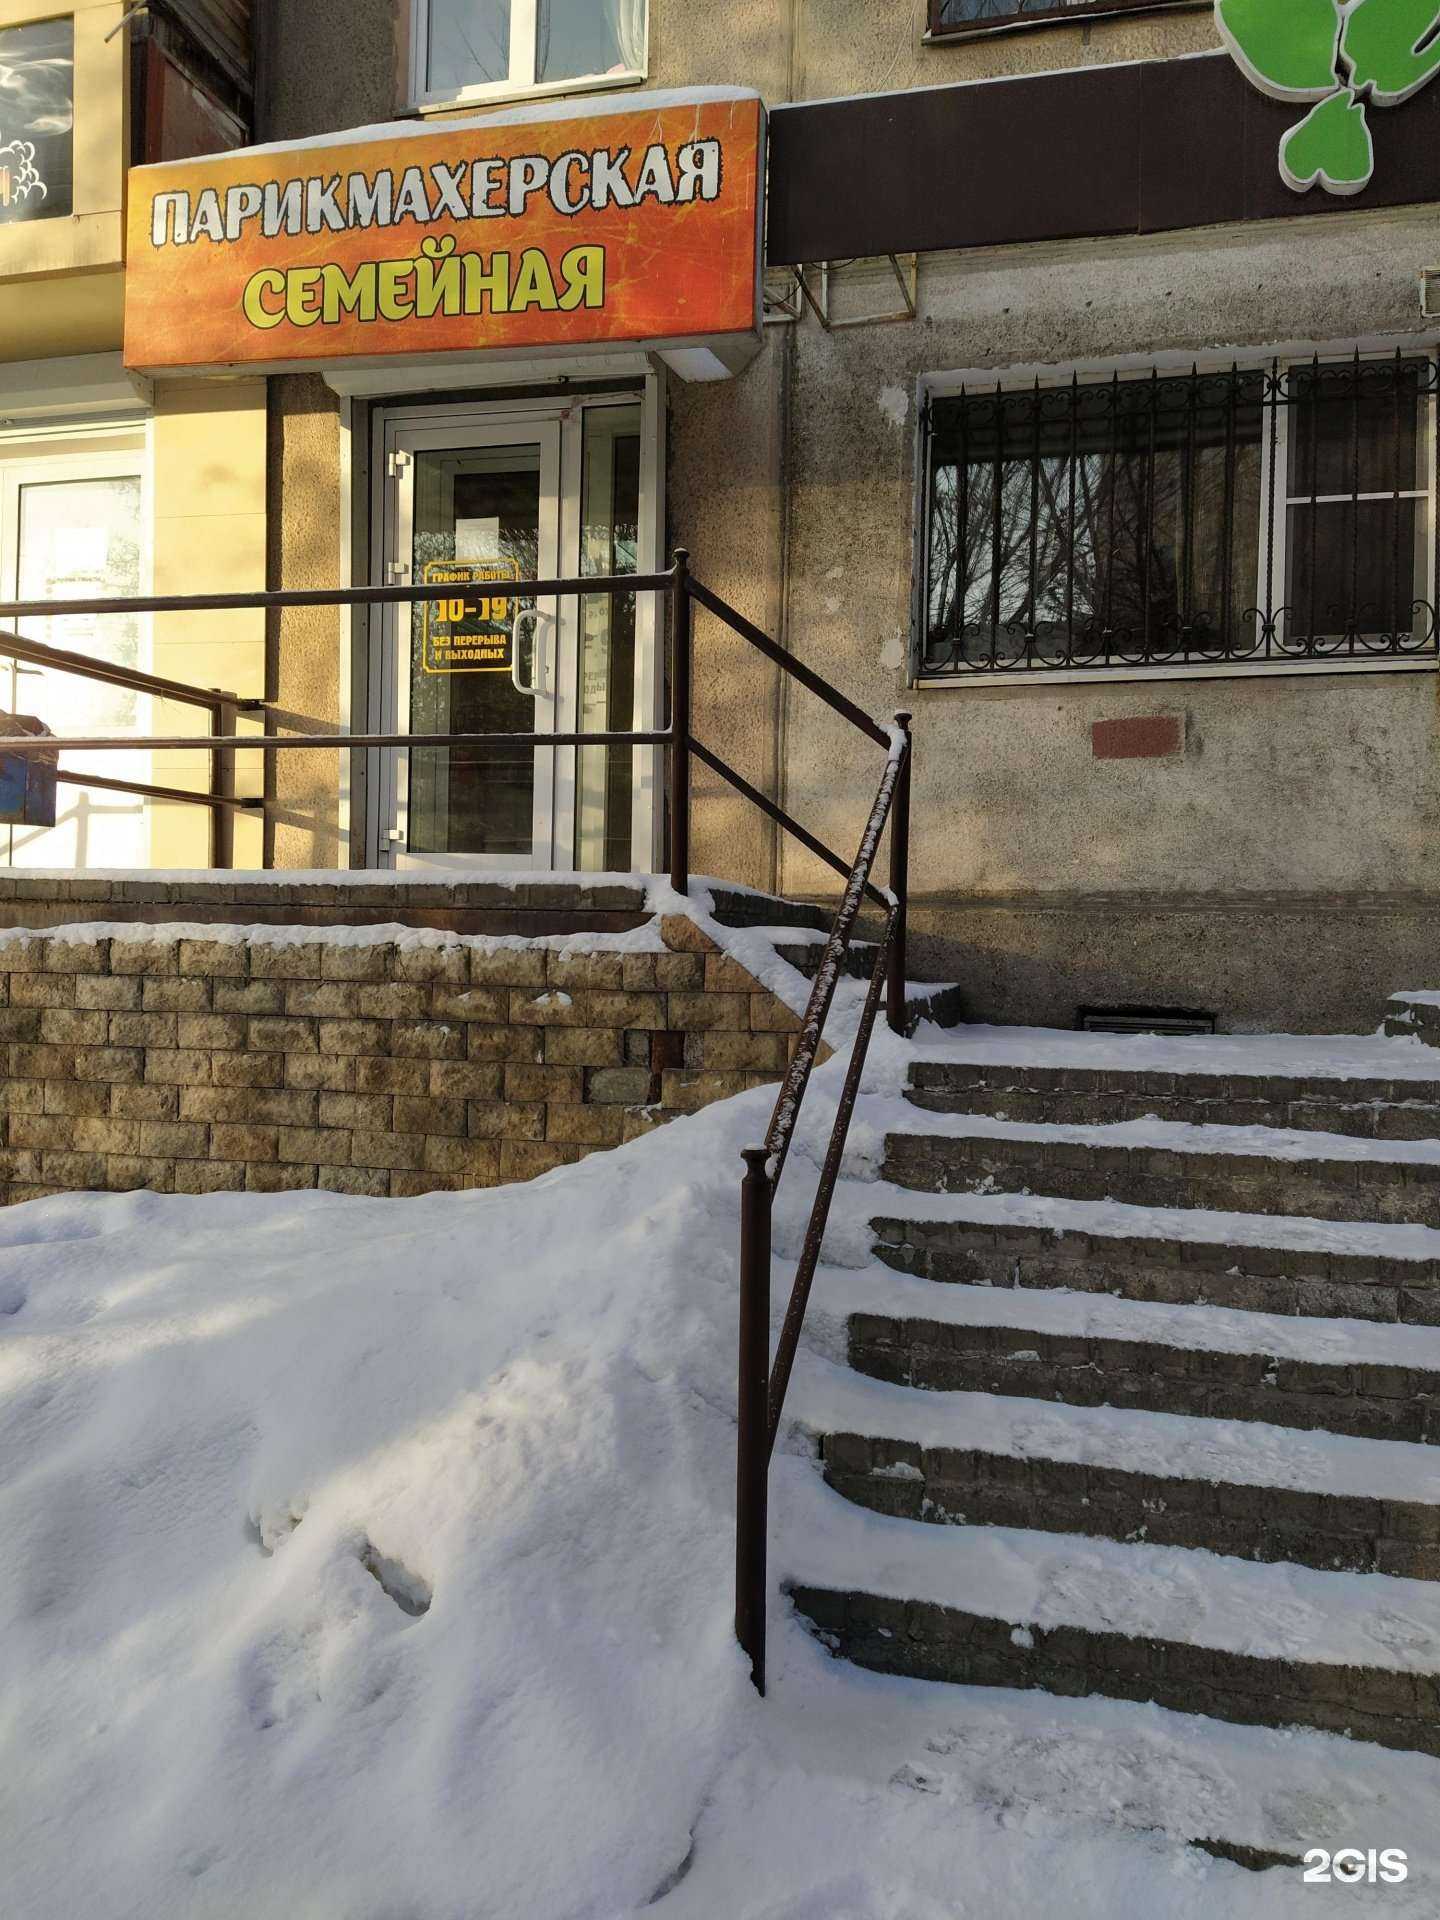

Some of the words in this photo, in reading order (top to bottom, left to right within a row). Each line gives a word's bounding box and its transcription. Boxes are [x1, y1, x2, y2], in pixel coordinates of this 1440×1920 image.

[151, 138, 722, 248] ПАРИКМАХЕРСКАЯ
[243, 235, 604, 329] СЕМЕЙНАЯ
[432, 572, 470, 582] ГРАФИК
[436, 597, 508, 621] 10-19
[432, 636, 450, 646] БЕЗ
[453, 634, 506, 645] ПЕРЕРЫВА
[434, 650, 442, 660] И
[445, 649, 504, 660] ВЫХОДНЫХ
